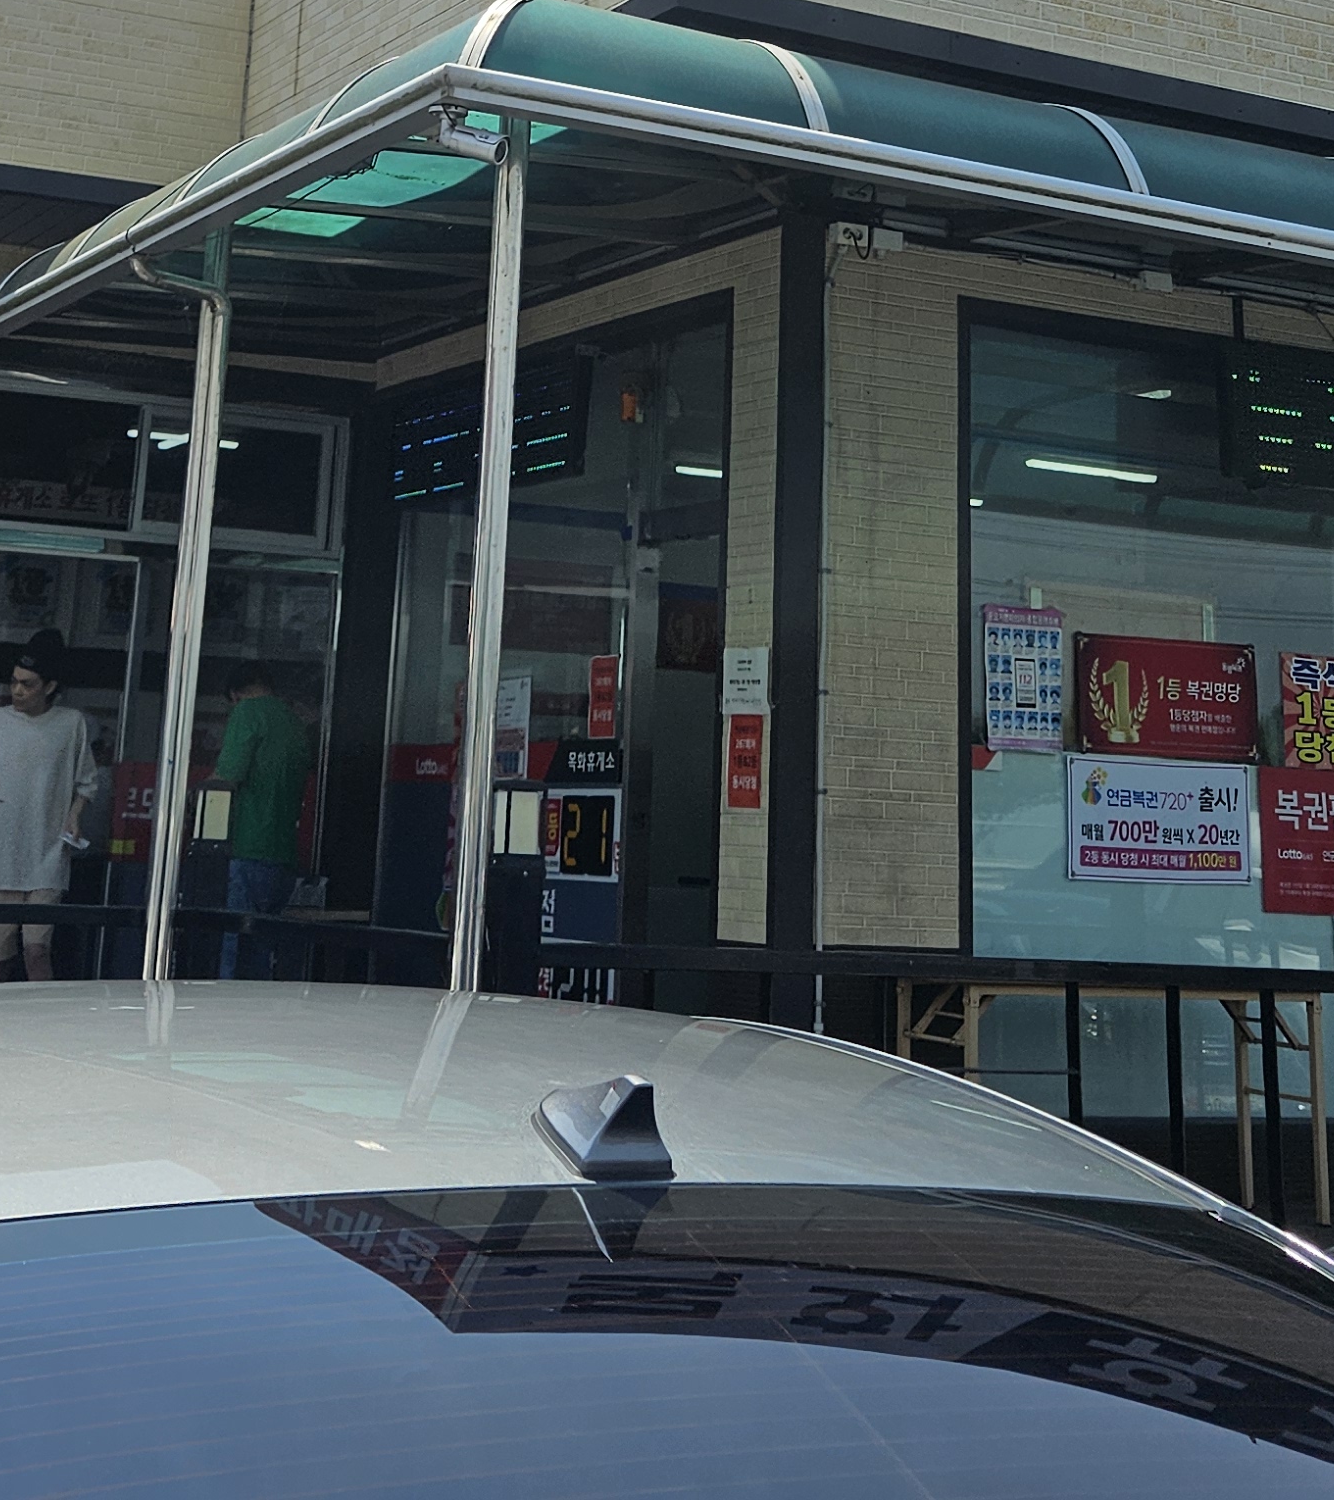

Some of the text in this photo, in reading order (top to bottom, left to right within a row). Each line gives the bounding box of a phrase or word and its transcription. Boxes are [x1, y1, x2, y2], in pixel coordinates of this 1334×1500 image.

[1157, 675, 1242, 703] 1등 복권명당
[567, 751, 615, 773] 목화휴게소
[1198, 786, 1239, 813] 출시!
[563, 803, 608, 867] 21
[1081, 823, 1104, 842] 매월
[1085, 850, 1099, 864] 2등
[1101, 851, 1119, 864] 동시
[1120, 852, 1139, 866] 당첨
[1140, 853, 1150, 865] 시
[1151, 854, 1168, 867] 최대
[1169, 854, 1187, 868] 매월
